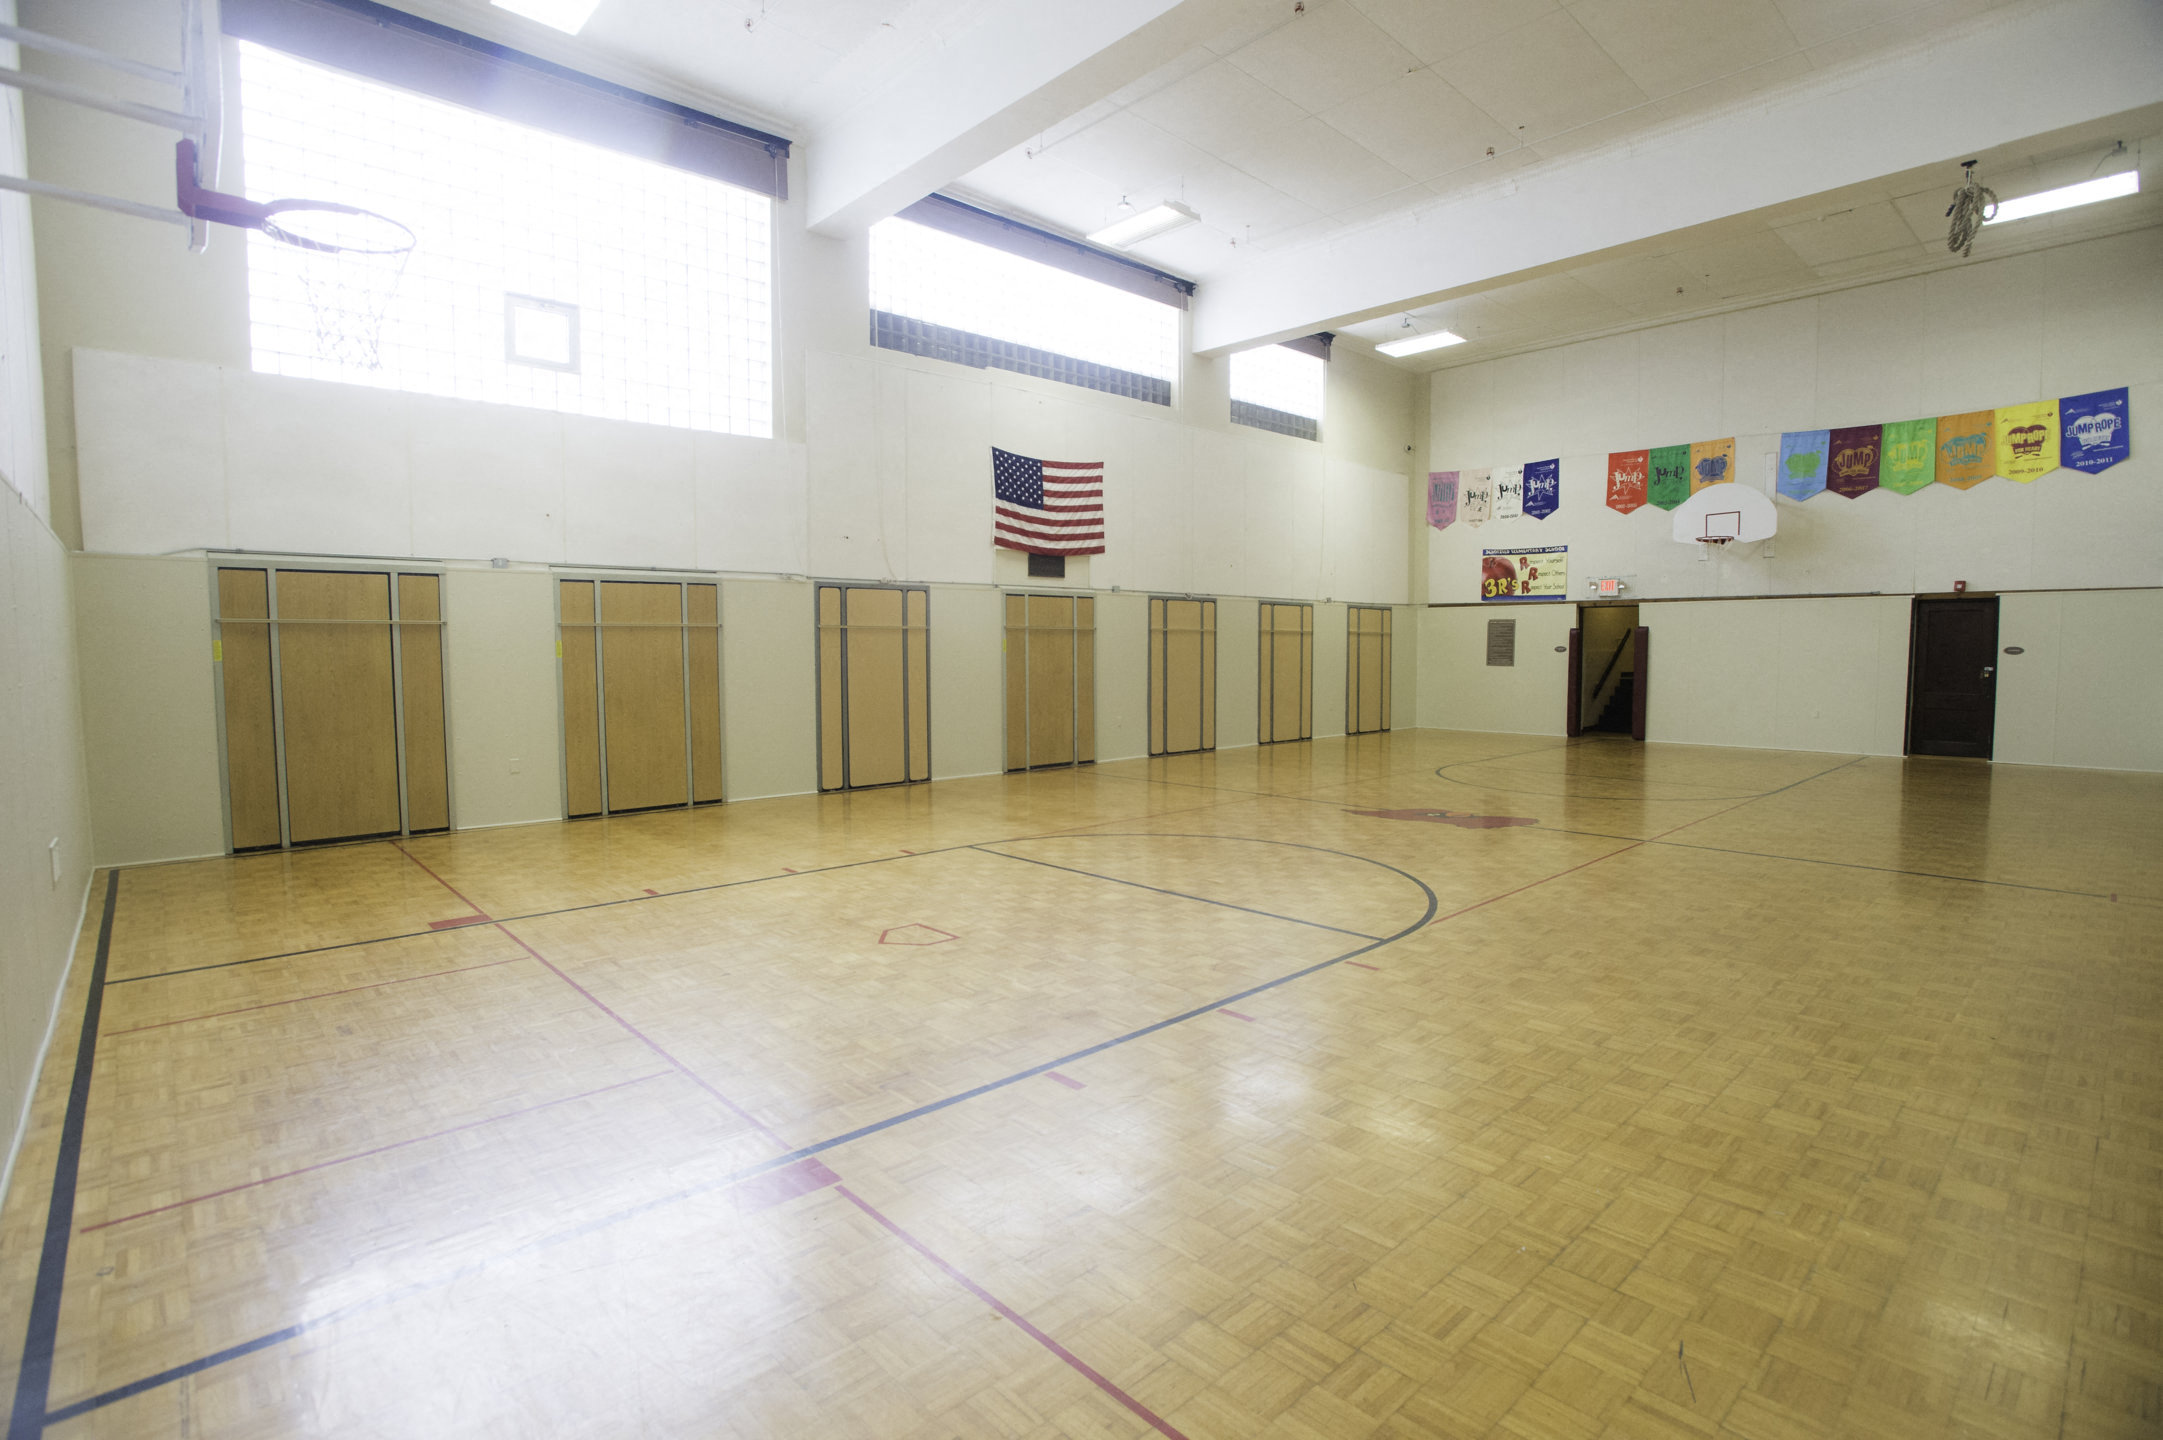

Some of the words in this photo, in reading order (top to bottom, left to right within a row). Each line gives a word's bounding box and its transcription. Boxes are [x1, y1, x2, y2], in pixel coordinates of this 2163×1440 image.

[2065, 423, 2093, 438] JUMP
[2095, 417, 2122, 433] ROPE
[2002, 432, 2027, 446] JUMP
[1840, 451, 1871, 469] JUMP
[2075, 456, 2113, 467] 2010-2011
[2008, 467, 2044, 475] 2009-2010
[1485, 577, 1519, 598] 3R's
[1600, 580, 1616, 592] EXIT
